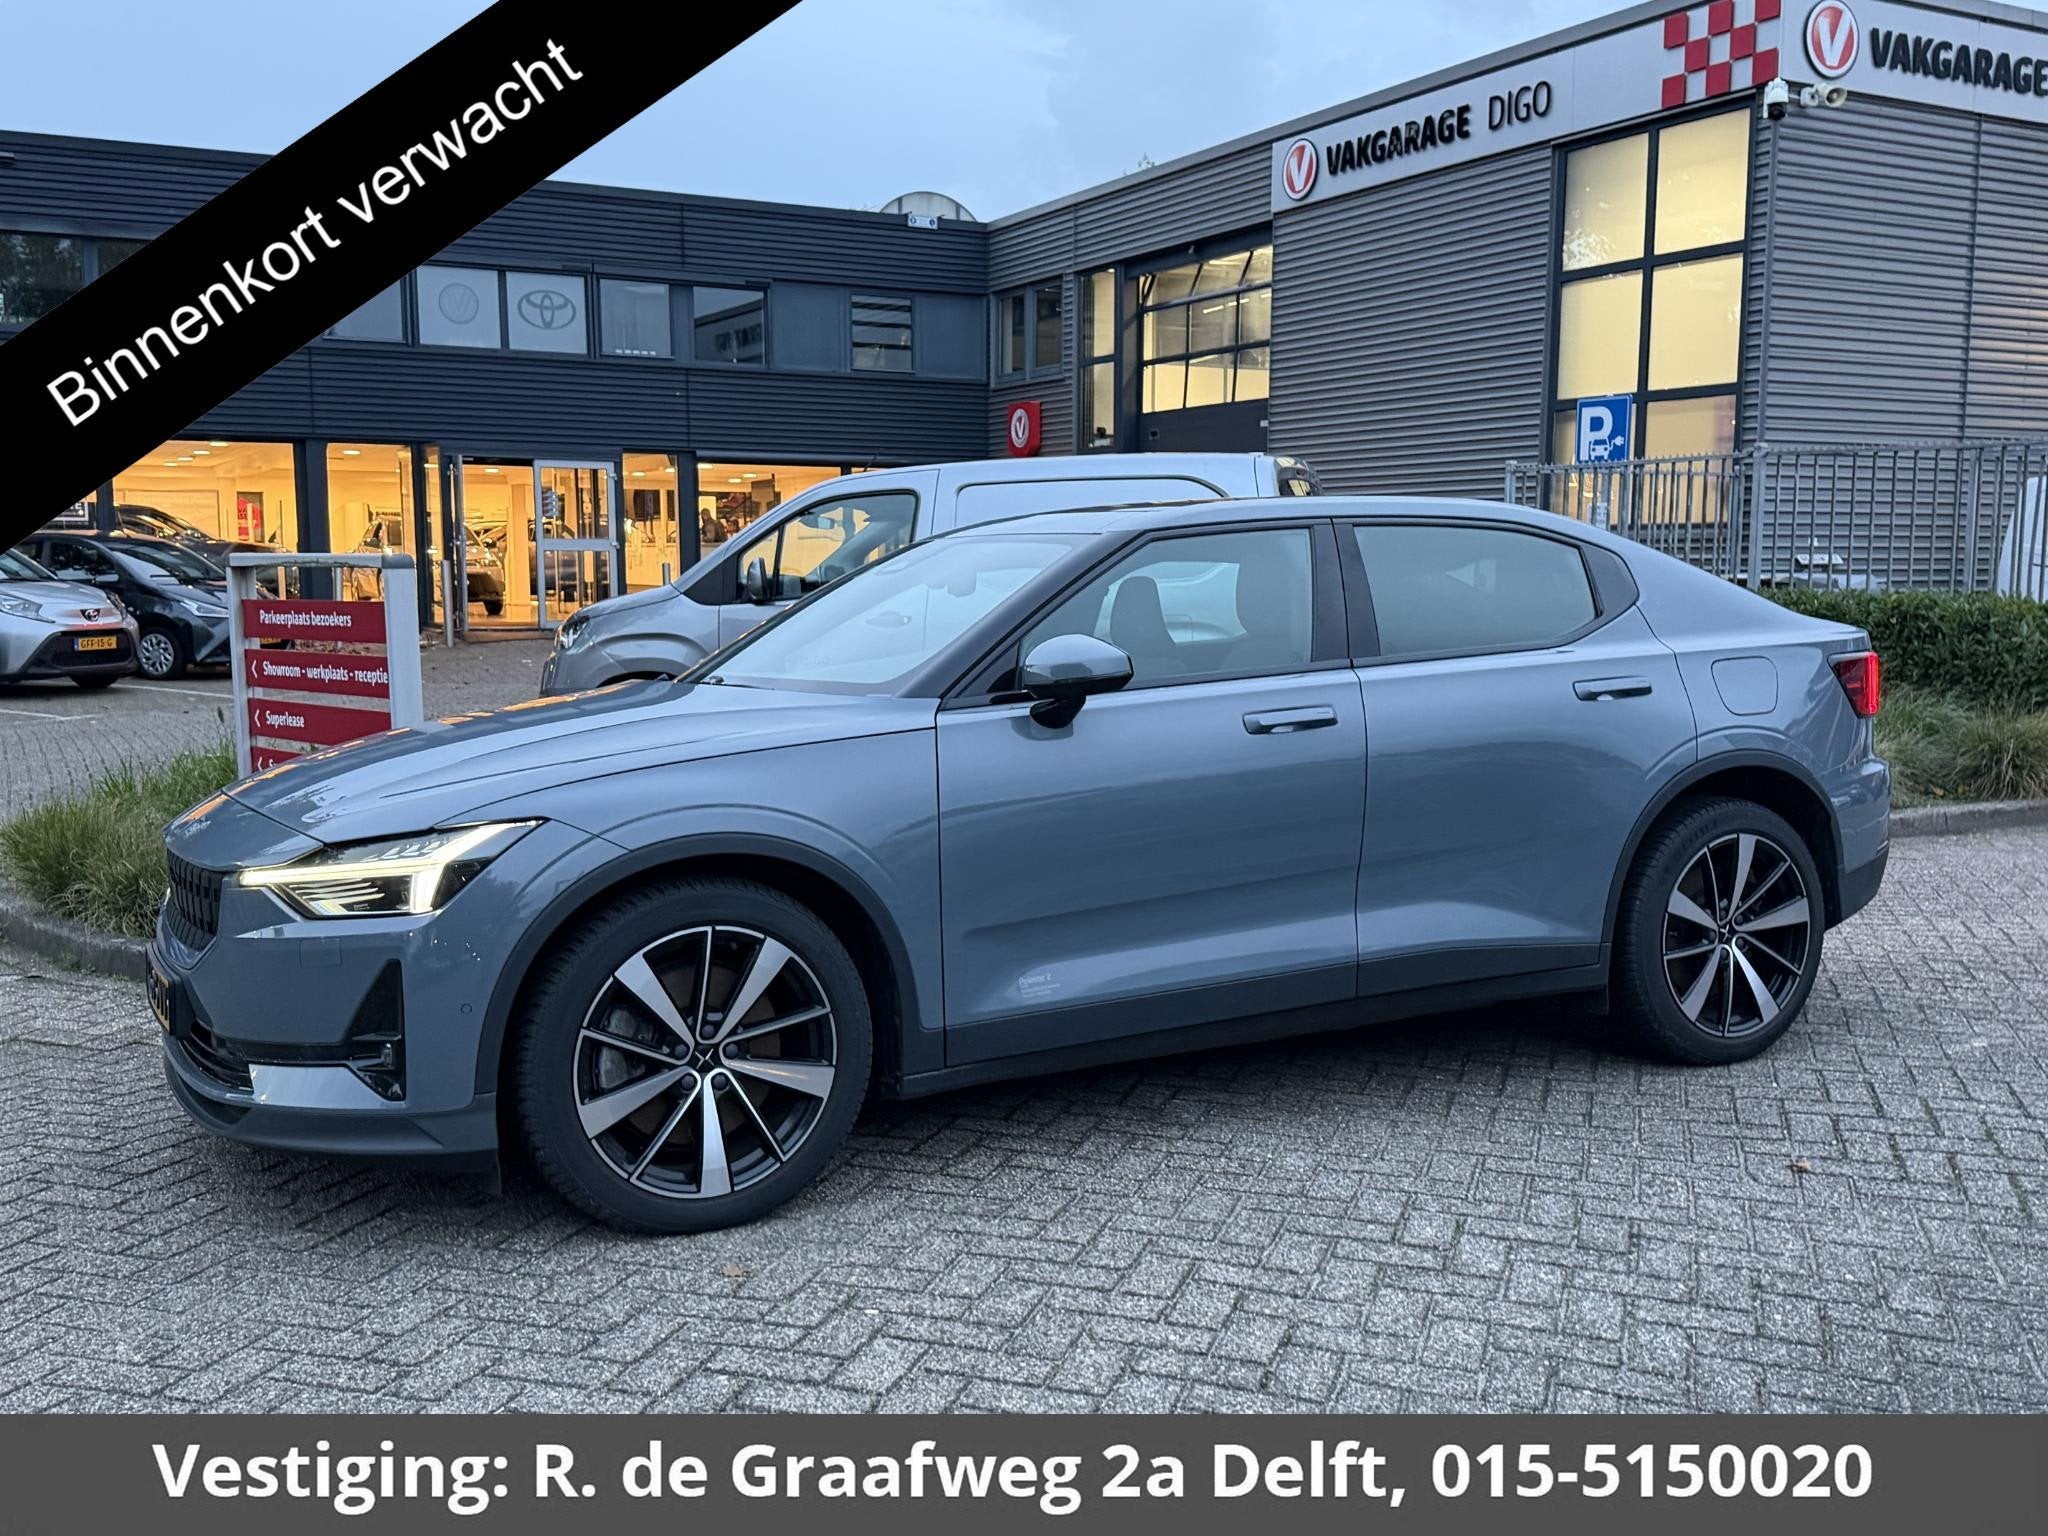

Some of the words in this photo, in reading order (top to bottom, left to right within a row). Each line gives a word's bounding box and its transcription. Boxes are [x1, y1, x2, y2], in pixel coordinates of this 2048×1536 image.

[1870, 27, 2048, 98] VAKGARAGE
[1326, 104, 1471, 175] VAKGARAGE
[1488, 81, 1553, 132] DIGO
[260, 610, 310, 628] Parkeerplaats
[311, 611, 352, 627] bezoekers
[262, 661, 301, 677] Showroom
[306, 664, 349, 683] werkplaats
[354, 667, 389, 685] receptie
[265, 710, 305, 729] Superlease
